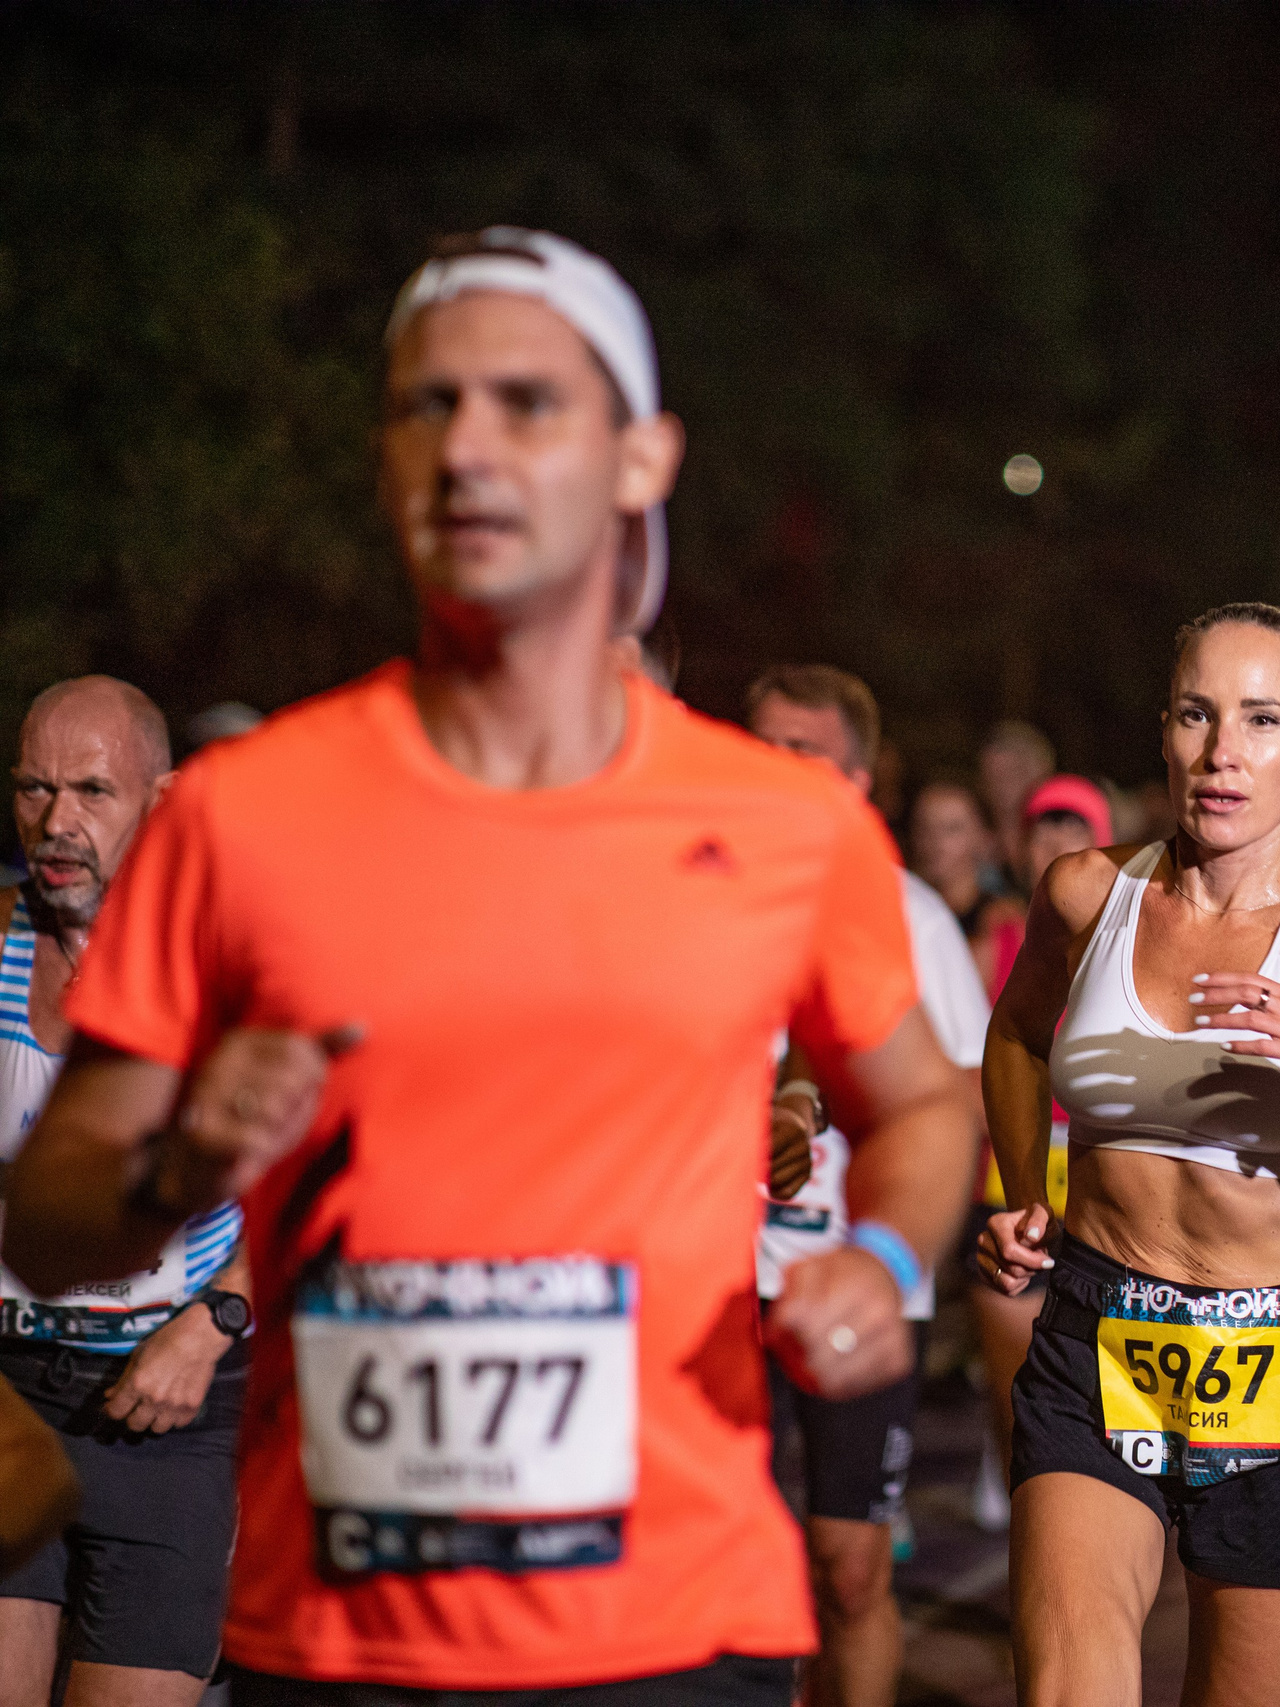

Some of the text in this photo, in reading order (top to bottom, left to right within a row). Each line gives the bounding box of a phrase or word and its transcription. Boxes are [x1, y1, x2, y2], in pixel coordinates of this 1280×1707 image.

[1125, 1338, 1275, 1405] 5967
[341, 1353, 586, 1448] 6177
[1167, 1403, 1228, 1428] ТАСИЯ
[1131, 1437, 1154, 1469] C
